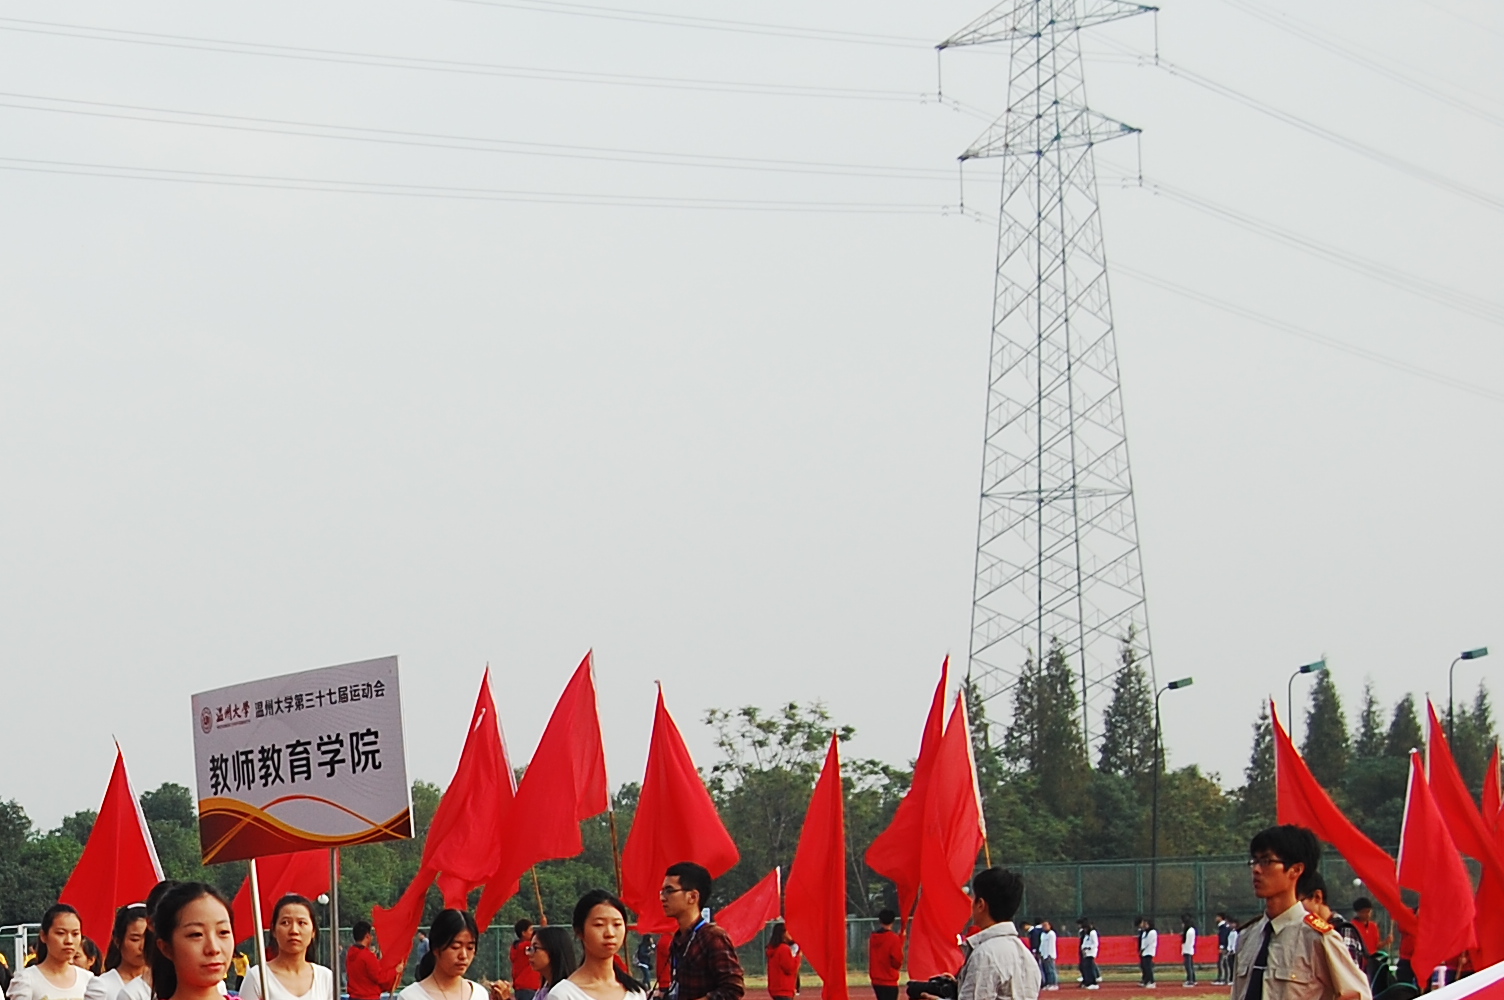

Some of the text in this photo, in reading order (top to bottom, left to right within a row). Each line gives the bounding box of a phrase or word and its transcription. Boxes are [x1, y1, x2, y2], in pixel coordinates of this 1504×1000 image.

[254, 679, 386, 719] 温州大学第三十七届运动会
[209, 728, 382, 796] 教师教育学院
